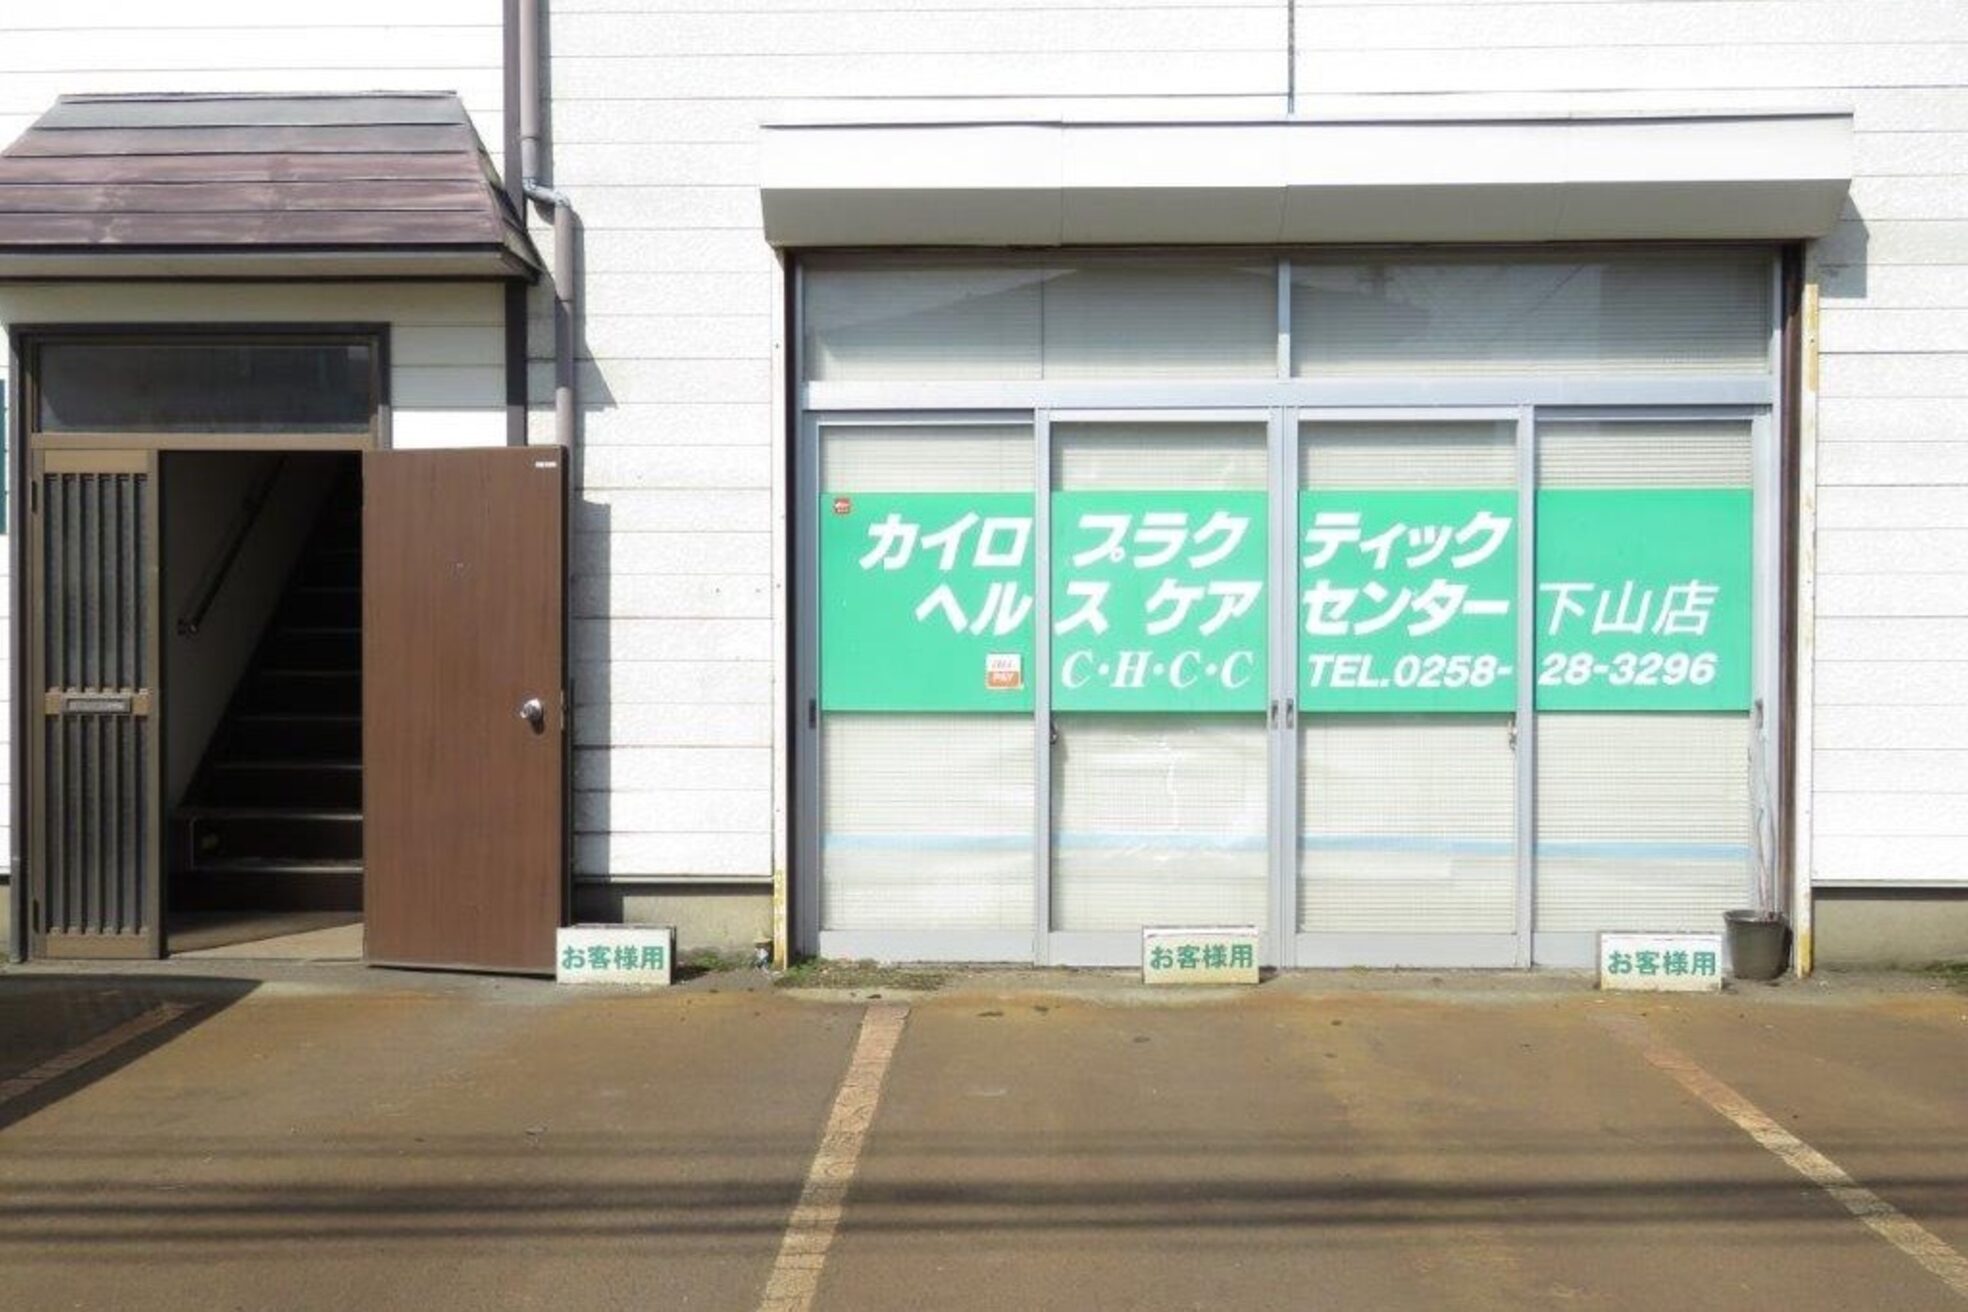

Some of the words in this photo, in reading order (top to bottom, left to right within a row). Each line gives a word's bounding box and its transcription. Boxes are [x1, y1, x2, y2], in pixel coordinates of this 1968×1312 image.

[1303, 578, 1509, 636] センター
[1540, 579, 1718, 636] 下山店
[1538, 652, 1717, 685] 28-3296
[562, 945, 665, 970] お客様用
[1150, 943, 1254, 969] お客様用
[1608, 950, 1716, 976] お客様用
